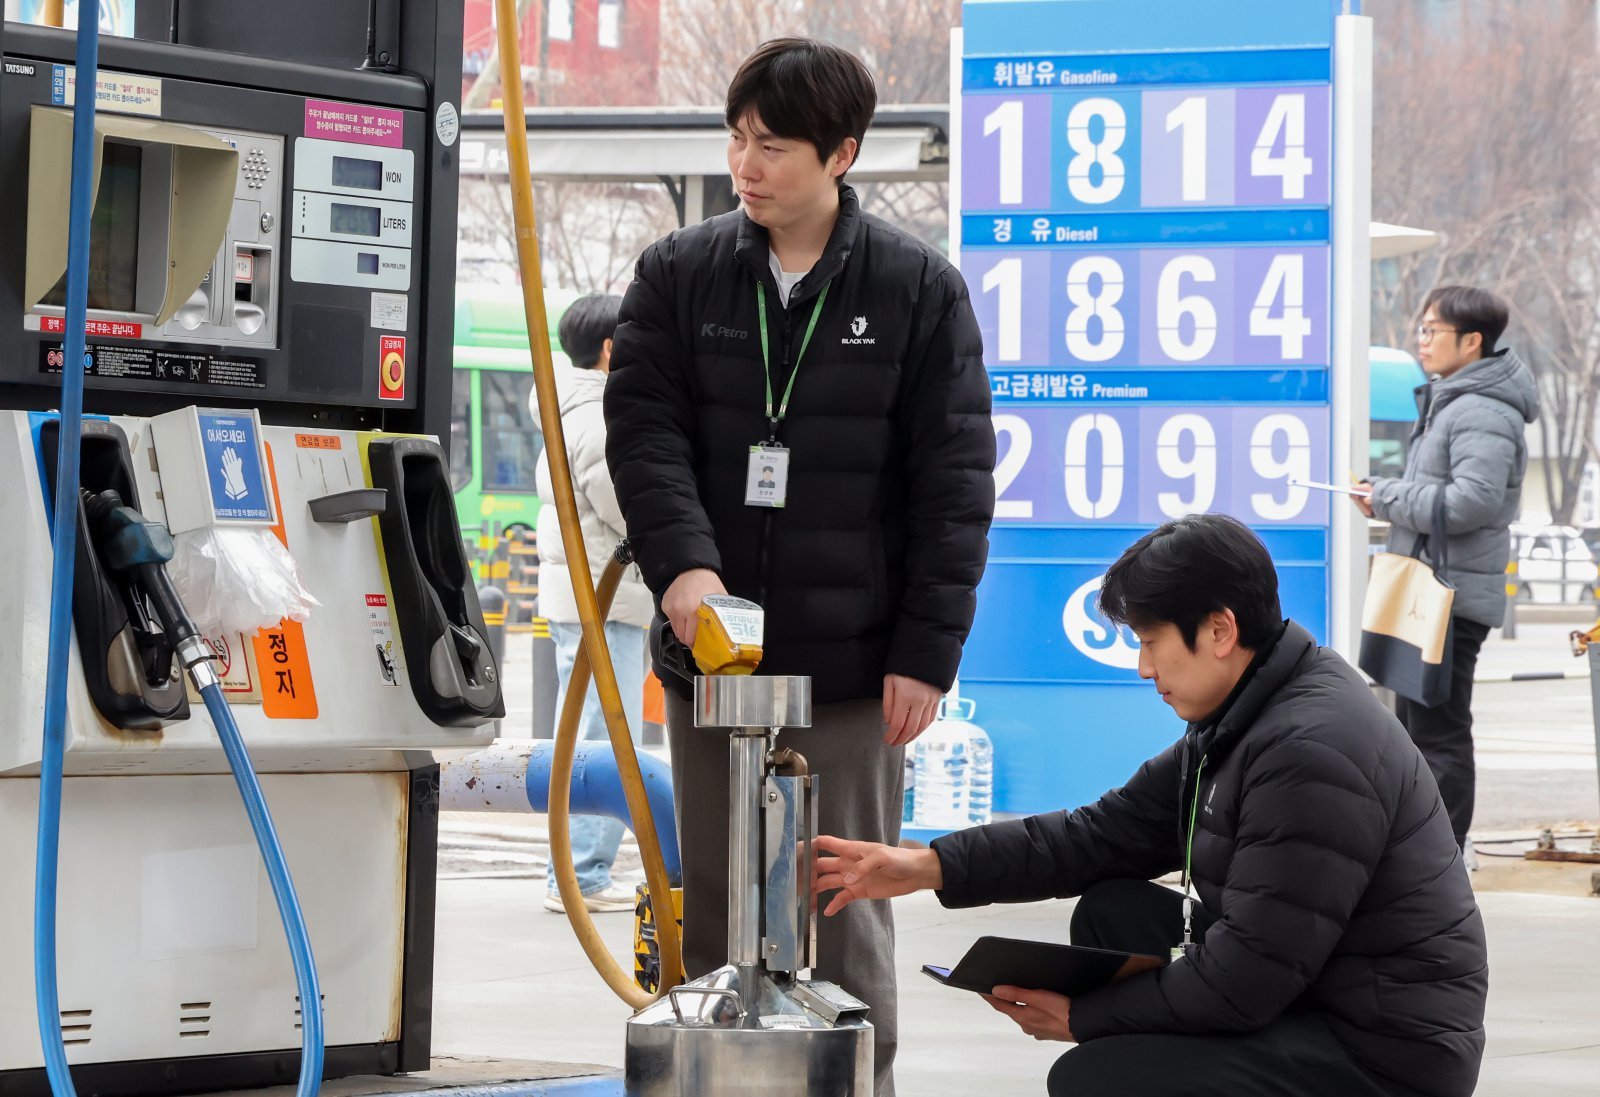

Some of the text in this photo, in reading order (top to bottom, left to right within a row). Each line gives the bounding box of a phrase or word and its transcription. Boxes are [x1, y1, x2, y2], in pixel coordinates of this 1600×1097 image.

[5, 63, 34, 75] TATSUNO
[993, 60, 1118, 86] 휘발유 Gasoline
[982, 92, 1313, 205] 1814
[386, 171, 402, 184] WON
[383, 217, 406, 230] LITERS
[992, 217, 1098, 243] 경 유 Diesel
[981, 254, 1312, 362] 1864
[112, 324, 135, 336] 끝납니다.
[701, 323, 748, 340] K Petro
[384, 339, 402, 349] 긴급정지
[993, 373, 1148, 399] 고급휘발유 Premium
[207, 428, 247, 443] 어서오세요!
[993, 413, 1311, 520] 2099
